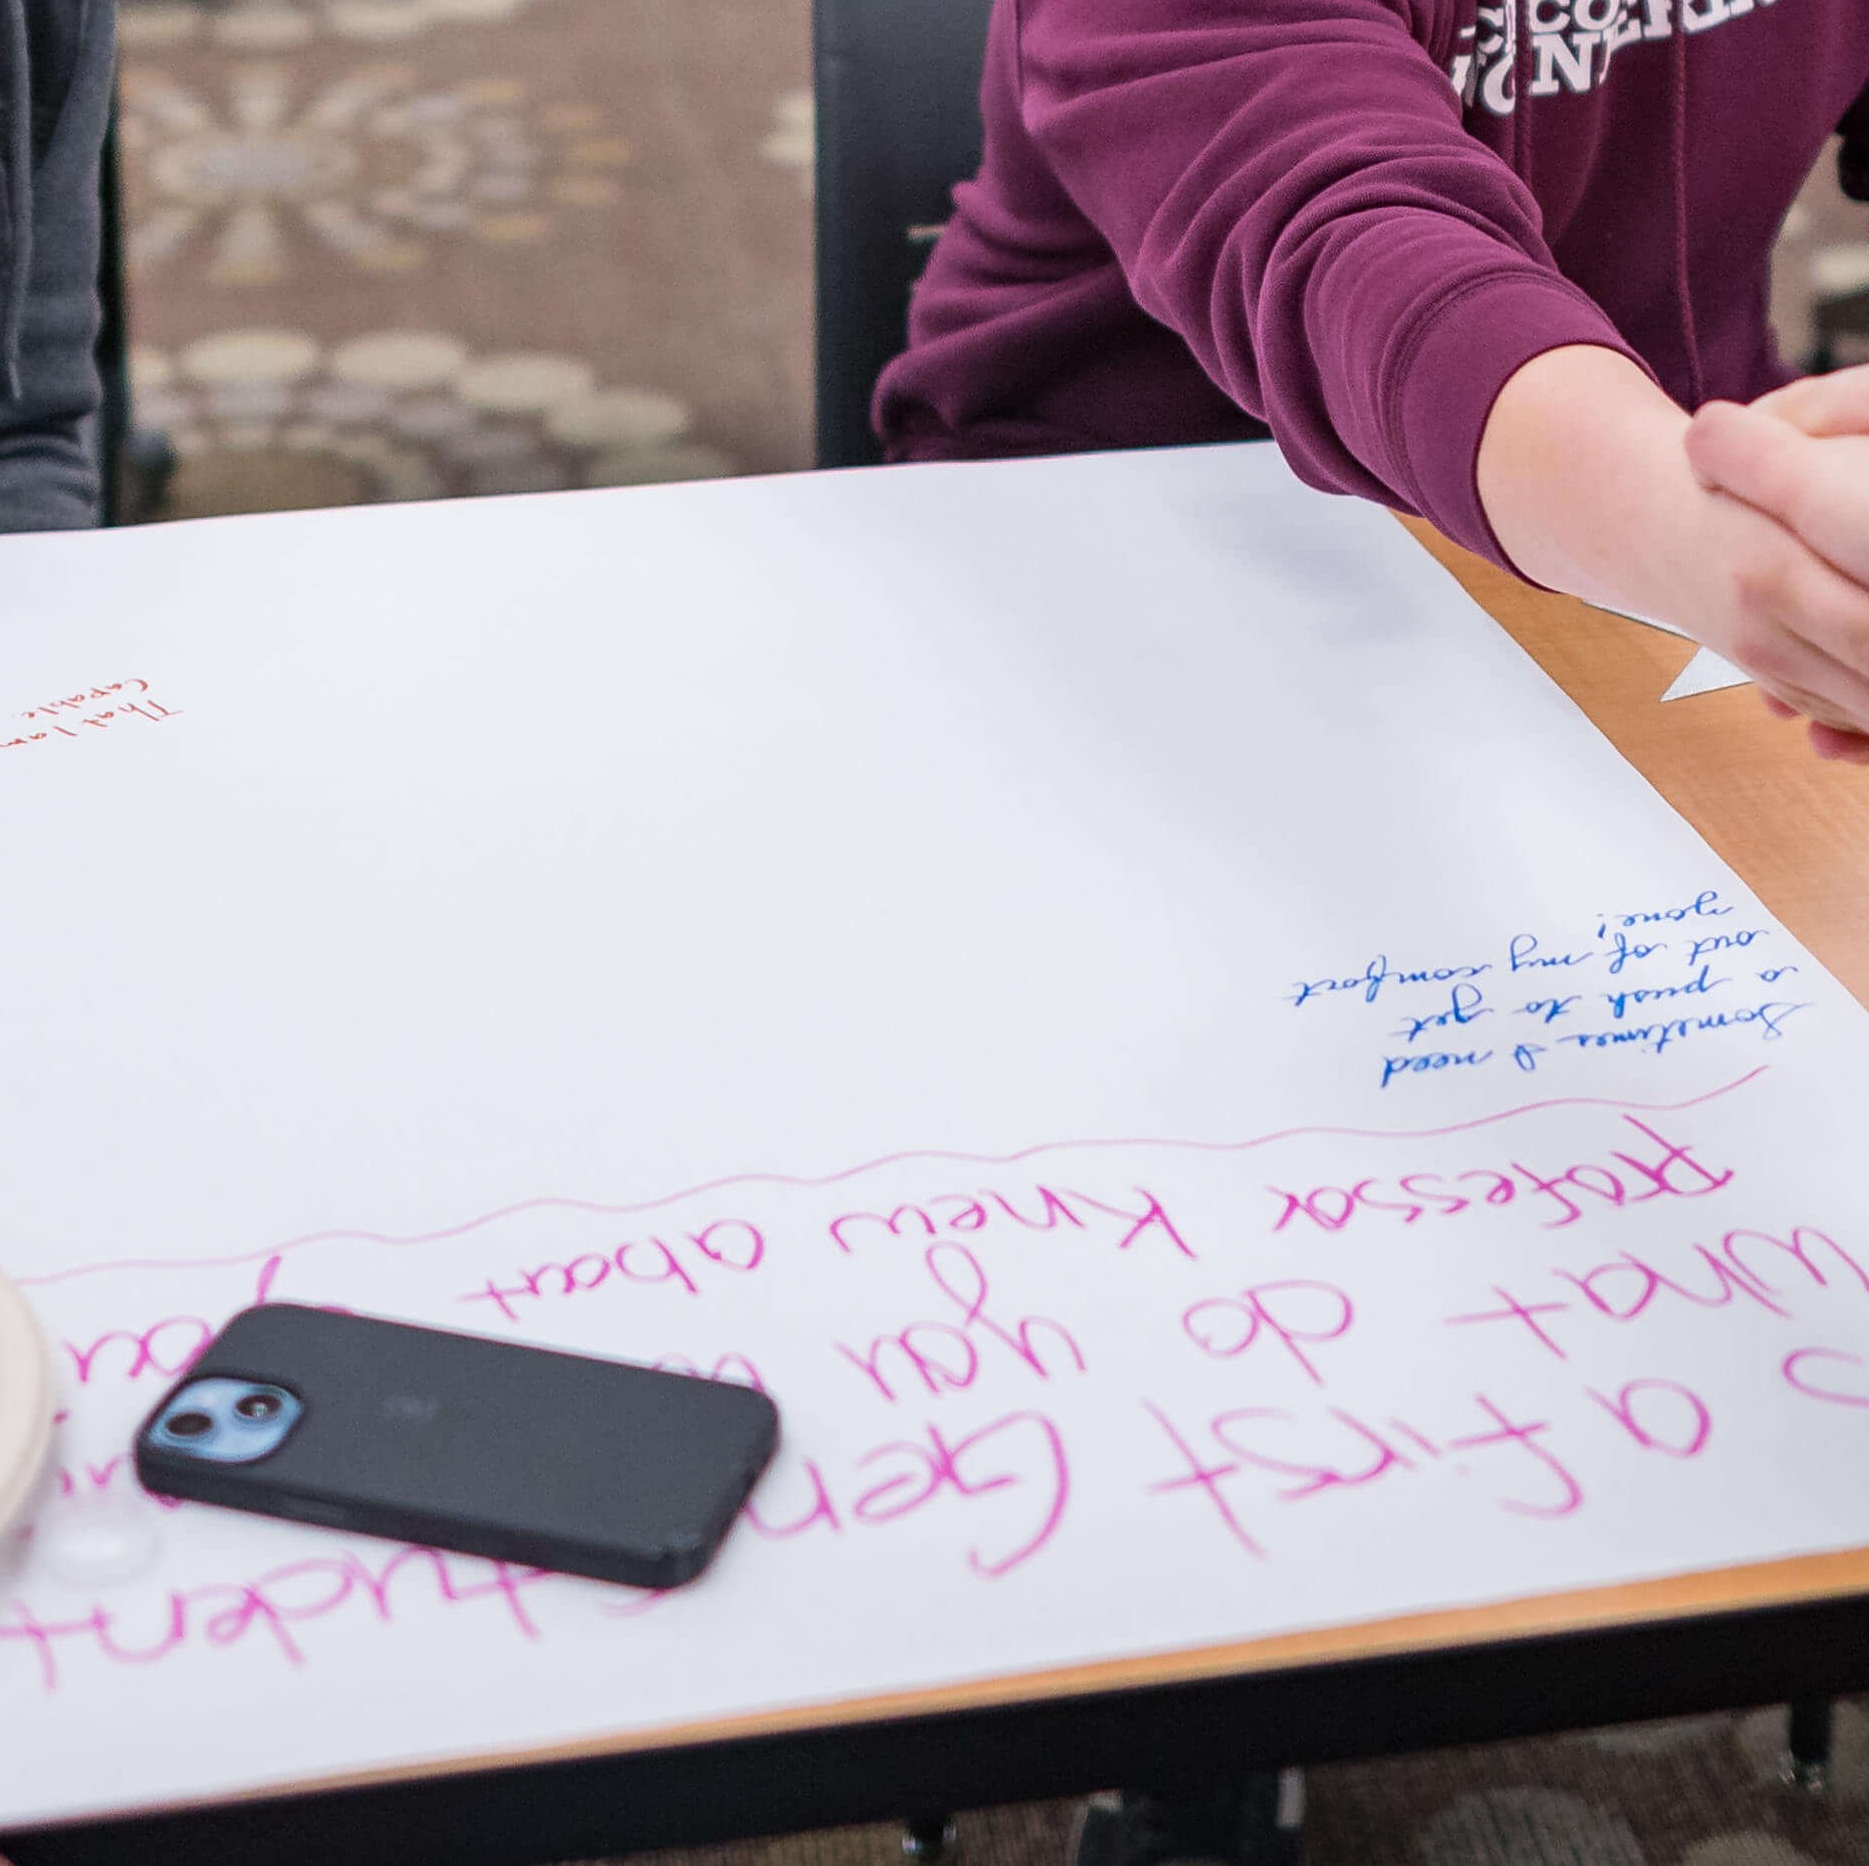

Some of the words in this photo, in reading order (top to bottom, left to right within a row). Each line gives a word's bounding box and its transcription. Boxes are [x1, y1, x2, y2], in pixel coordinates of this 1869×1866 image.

[1593, 889, 1736, 940] zone!
[1508, 933, 1596, 970] my
[1603, 932, 1669, 973] of
[1685, 928, 1770, 967] out
[1753, 964, 1800, 985] a
[1282, 954, 1494, 1008] comfort
[1605, 964, 1734, 1019] push
[1385, 983, 1496, 1044] get
[1511, 994, 1584, 1024] to
[1555, 1001, 1815, 1055] Sometimes
[1379, 1050, 1495, 1090] need
[1511, 1042, 1548, 1074] I
[1263, 1113, 1737, 1232] professor
[454, 1218, 767, 1325] about
[833, 1240, 1087, 1404] you
[1182, 1278, 1355, 1388] do
[1584, 1377, 1714, 1462] a
[740, 1408, 1071, 1582] Gen
[1140, 1392, 1585, 1563] first
